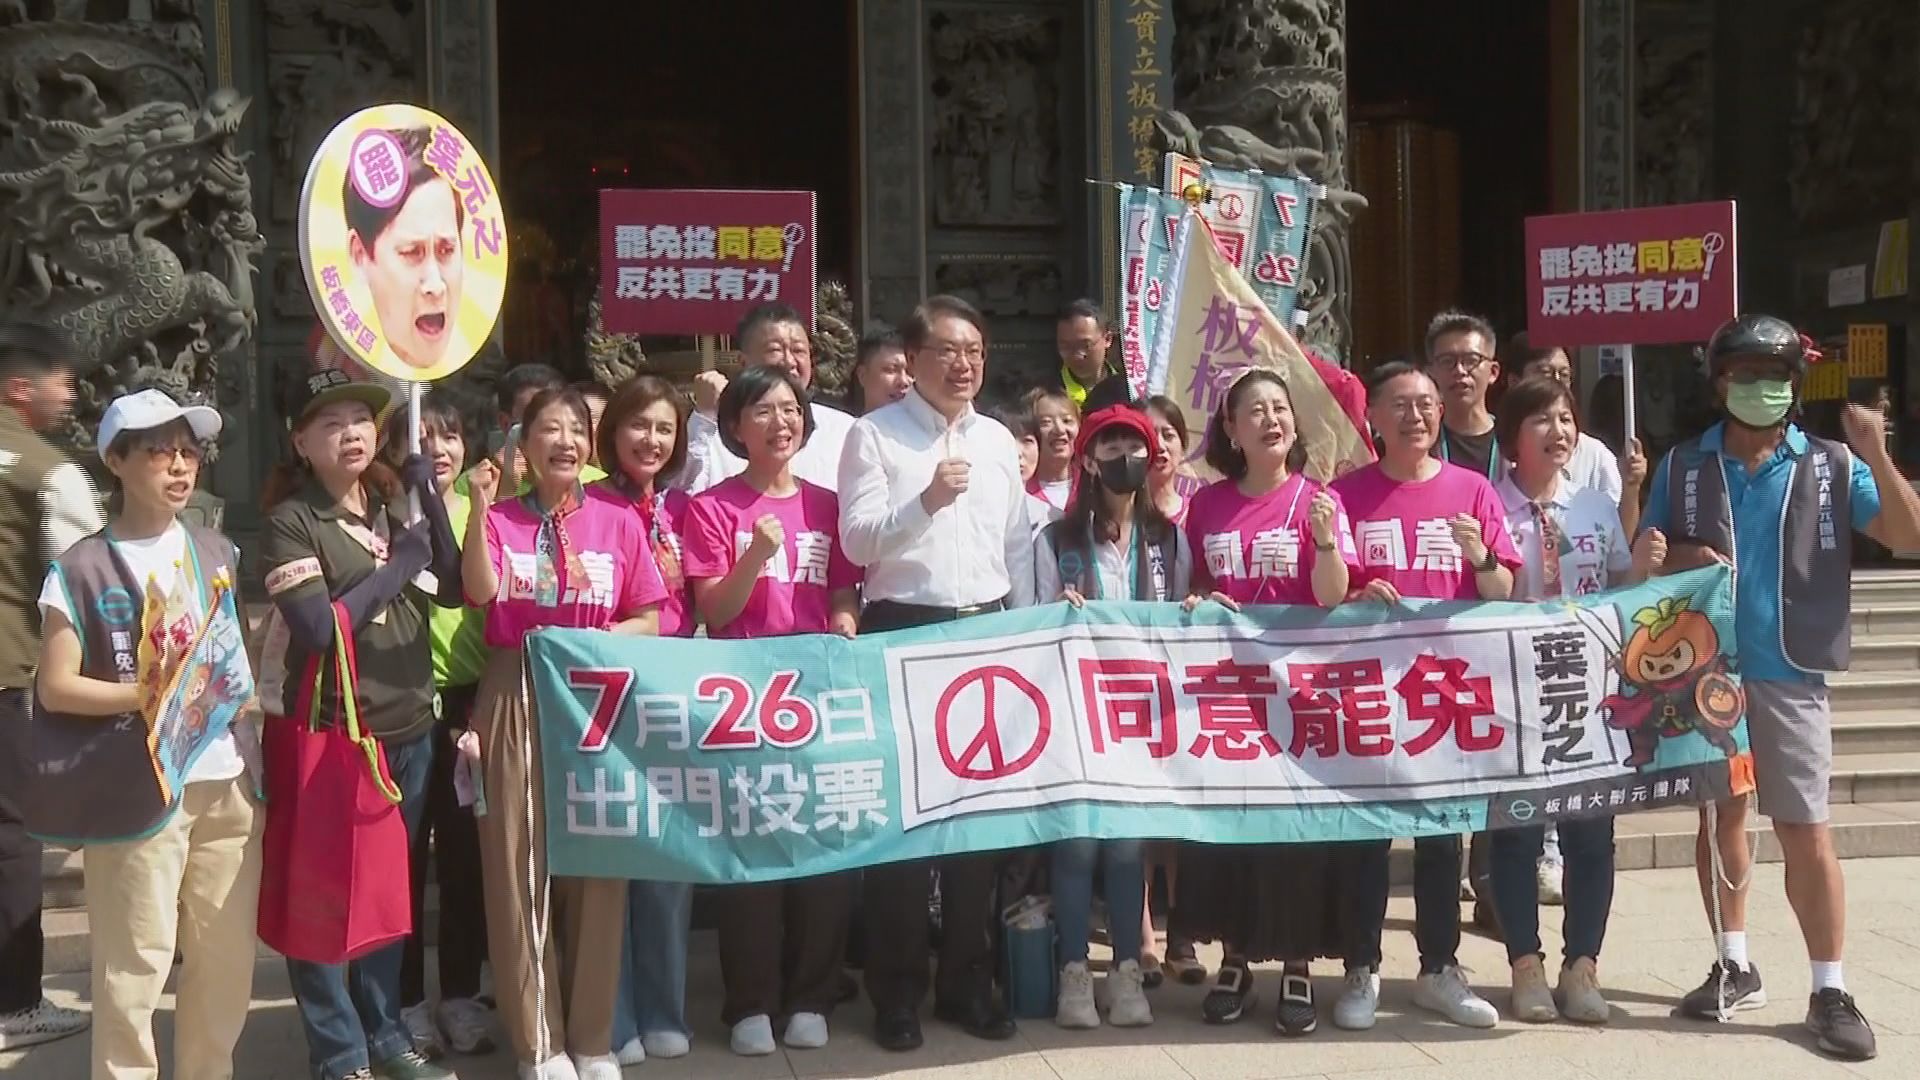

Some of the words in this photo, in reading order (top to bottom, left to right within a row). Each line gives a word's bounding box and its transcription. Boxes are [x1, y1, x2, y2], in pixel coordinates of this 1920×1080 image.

[358, 140, 400, 194] 罷
[425, 126, 502, 259] 葉元之
[319, 265, 378, 354] 板橋東區
[615, 266, 779, 300] 反共更有力
[1541, 277, 1699, 316] 反共更有力
[1202, 528, 1301, 579] 同意
[1355, 517, 1463, 573] 同意
[565, 667, 878, 752] 7月26日
[1076, 653, 1506, 762] 同意罷免
[1531, 625, 1593, 768] 葉元之
[565, 760, 891, 839] 出門投票
[1543, 775, 1693, 816] 板橋大刪元團隊
